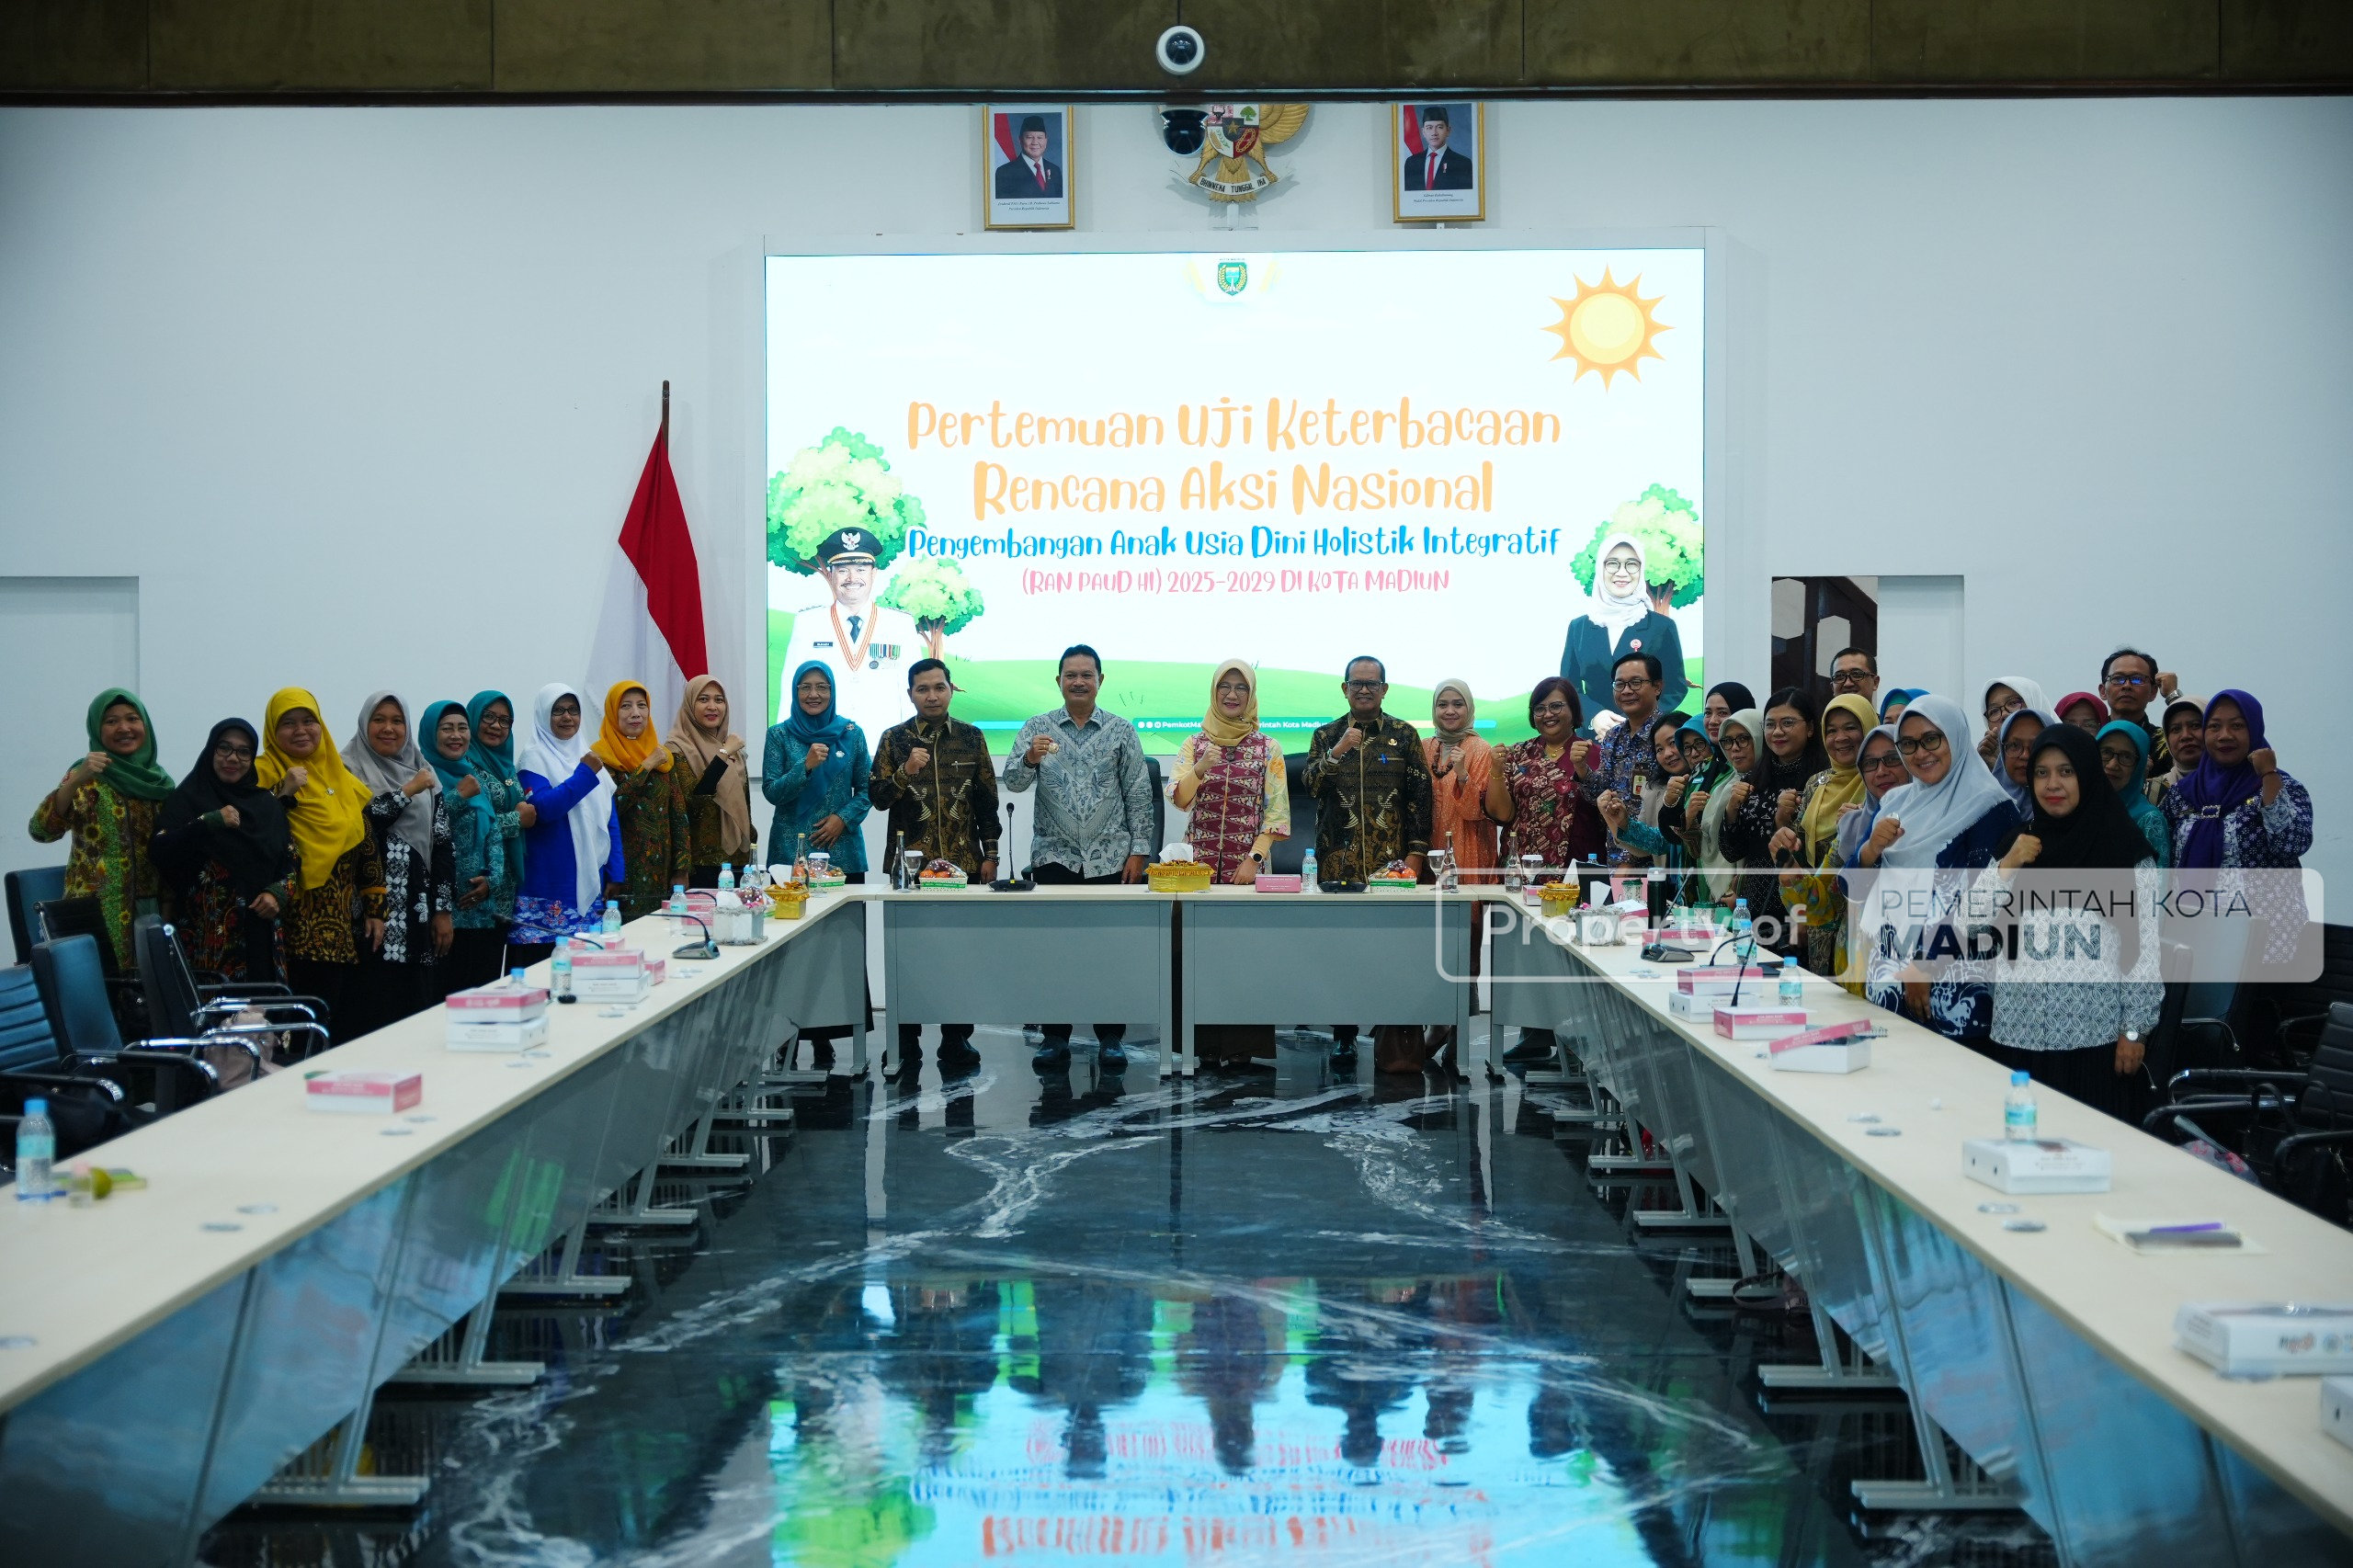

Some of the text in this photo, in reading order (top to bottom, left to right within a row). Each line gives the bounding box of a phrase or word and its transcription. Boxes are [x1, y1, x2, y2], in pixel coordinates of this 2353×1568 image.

[1199, 177, 1225, 192] BHINNEKA
[1231, 183, 1255, 193] TUNGGAL
[908, 400, 1165, 449] Pertemuan
[1267, 396, 1561, 452] Keterbacaan
[974, 460, 1494, 521] Rencana Aksi Nasional
[908, 525, 1561, 560] Pengembangan Anak Usia Dini Holistik Integratif
[1022, 567, 1449, 595] (RAN PAUD HI) 2025-2029 DI KOTA MADIUN
